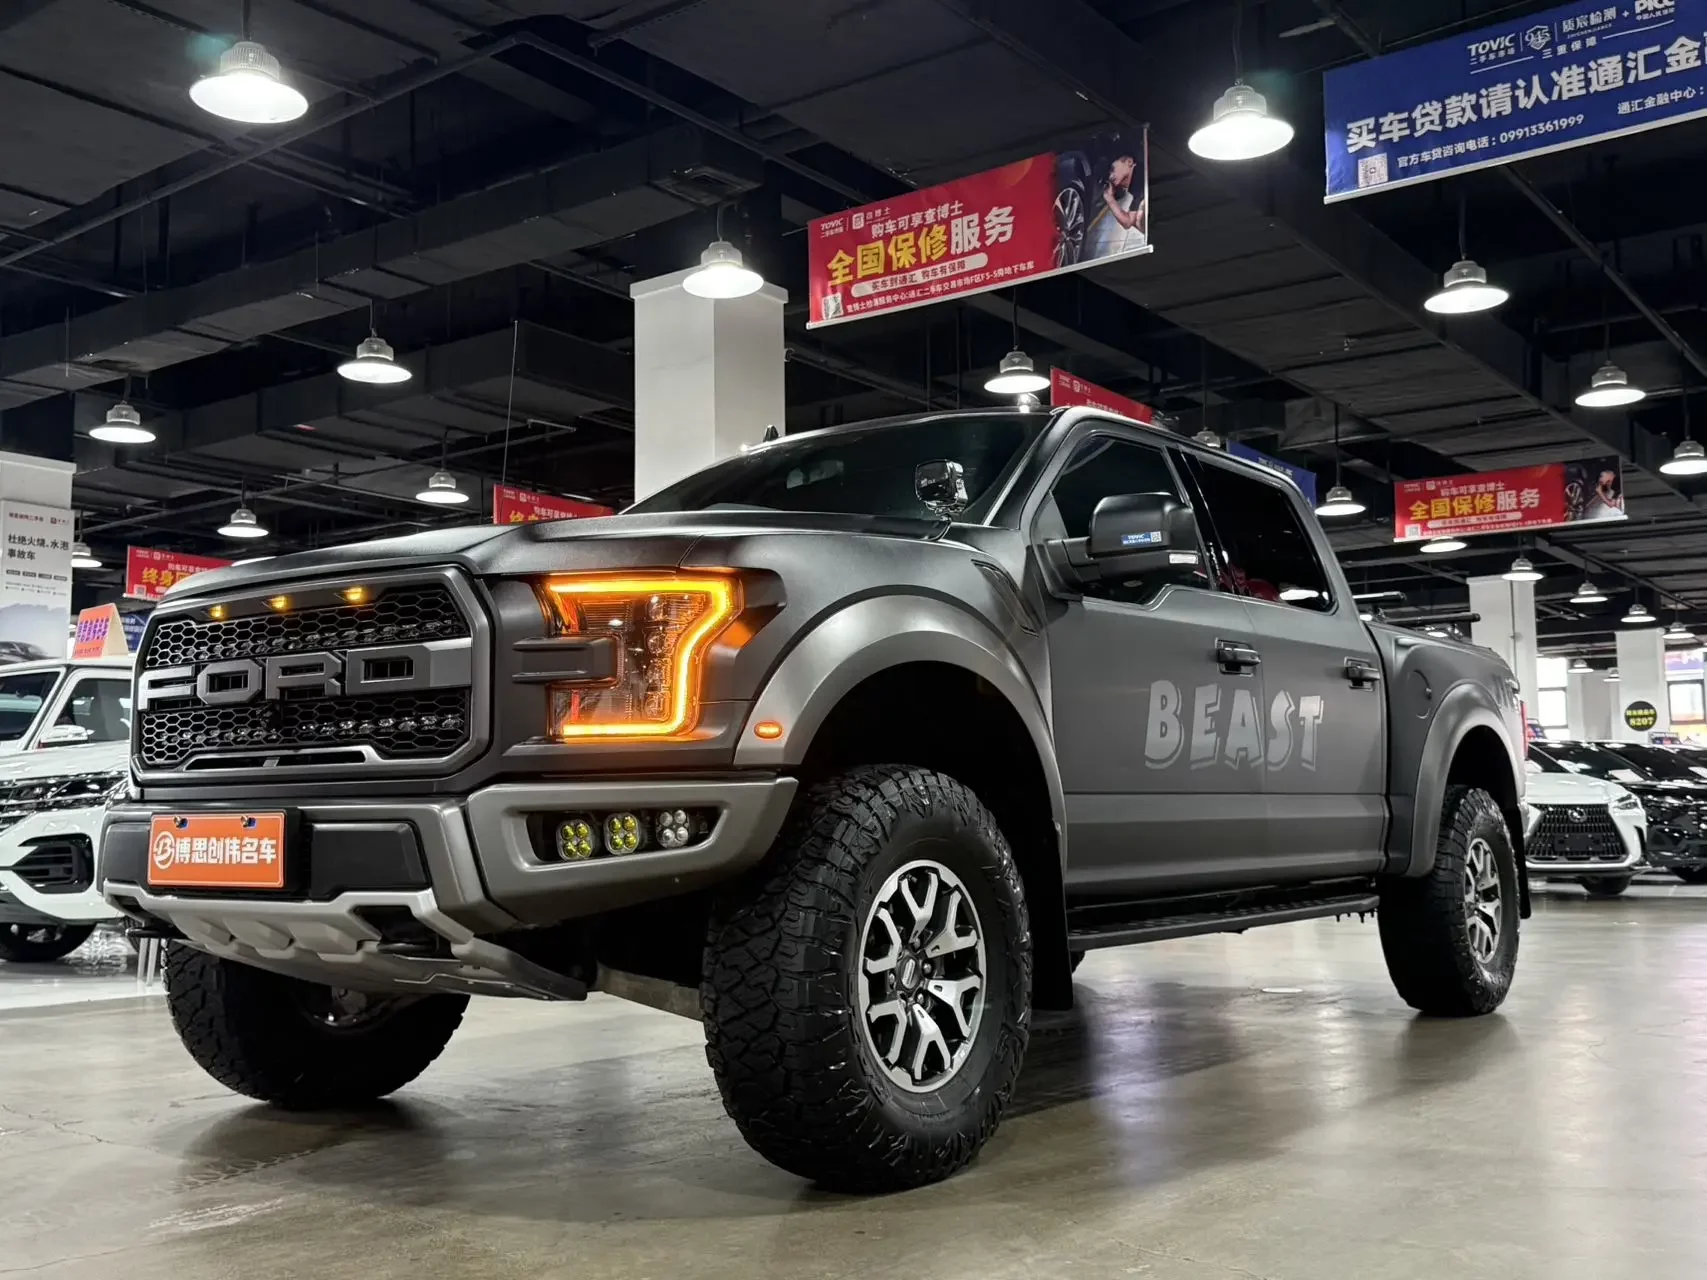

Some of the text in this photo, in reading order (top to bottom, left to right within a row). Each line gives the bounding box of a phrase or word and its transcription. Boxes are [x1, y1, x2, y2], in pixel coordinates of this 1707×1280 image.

[1467, 33, 1516, 57] TOVIC
[1346, 31, 1707, 154] 买车贷款请认准通汇金
[871, 200, 963, 239] 购车可享查博士
[827, 206, 1015, 287] 全国保修服务
[1410, 488, 1540, 521] 全国保修服务
[137, 645, 432, 712] FORD
[1145, 680, 1325, 772] BEAST
[174, 836, 277, 865] 博思创伟名车
